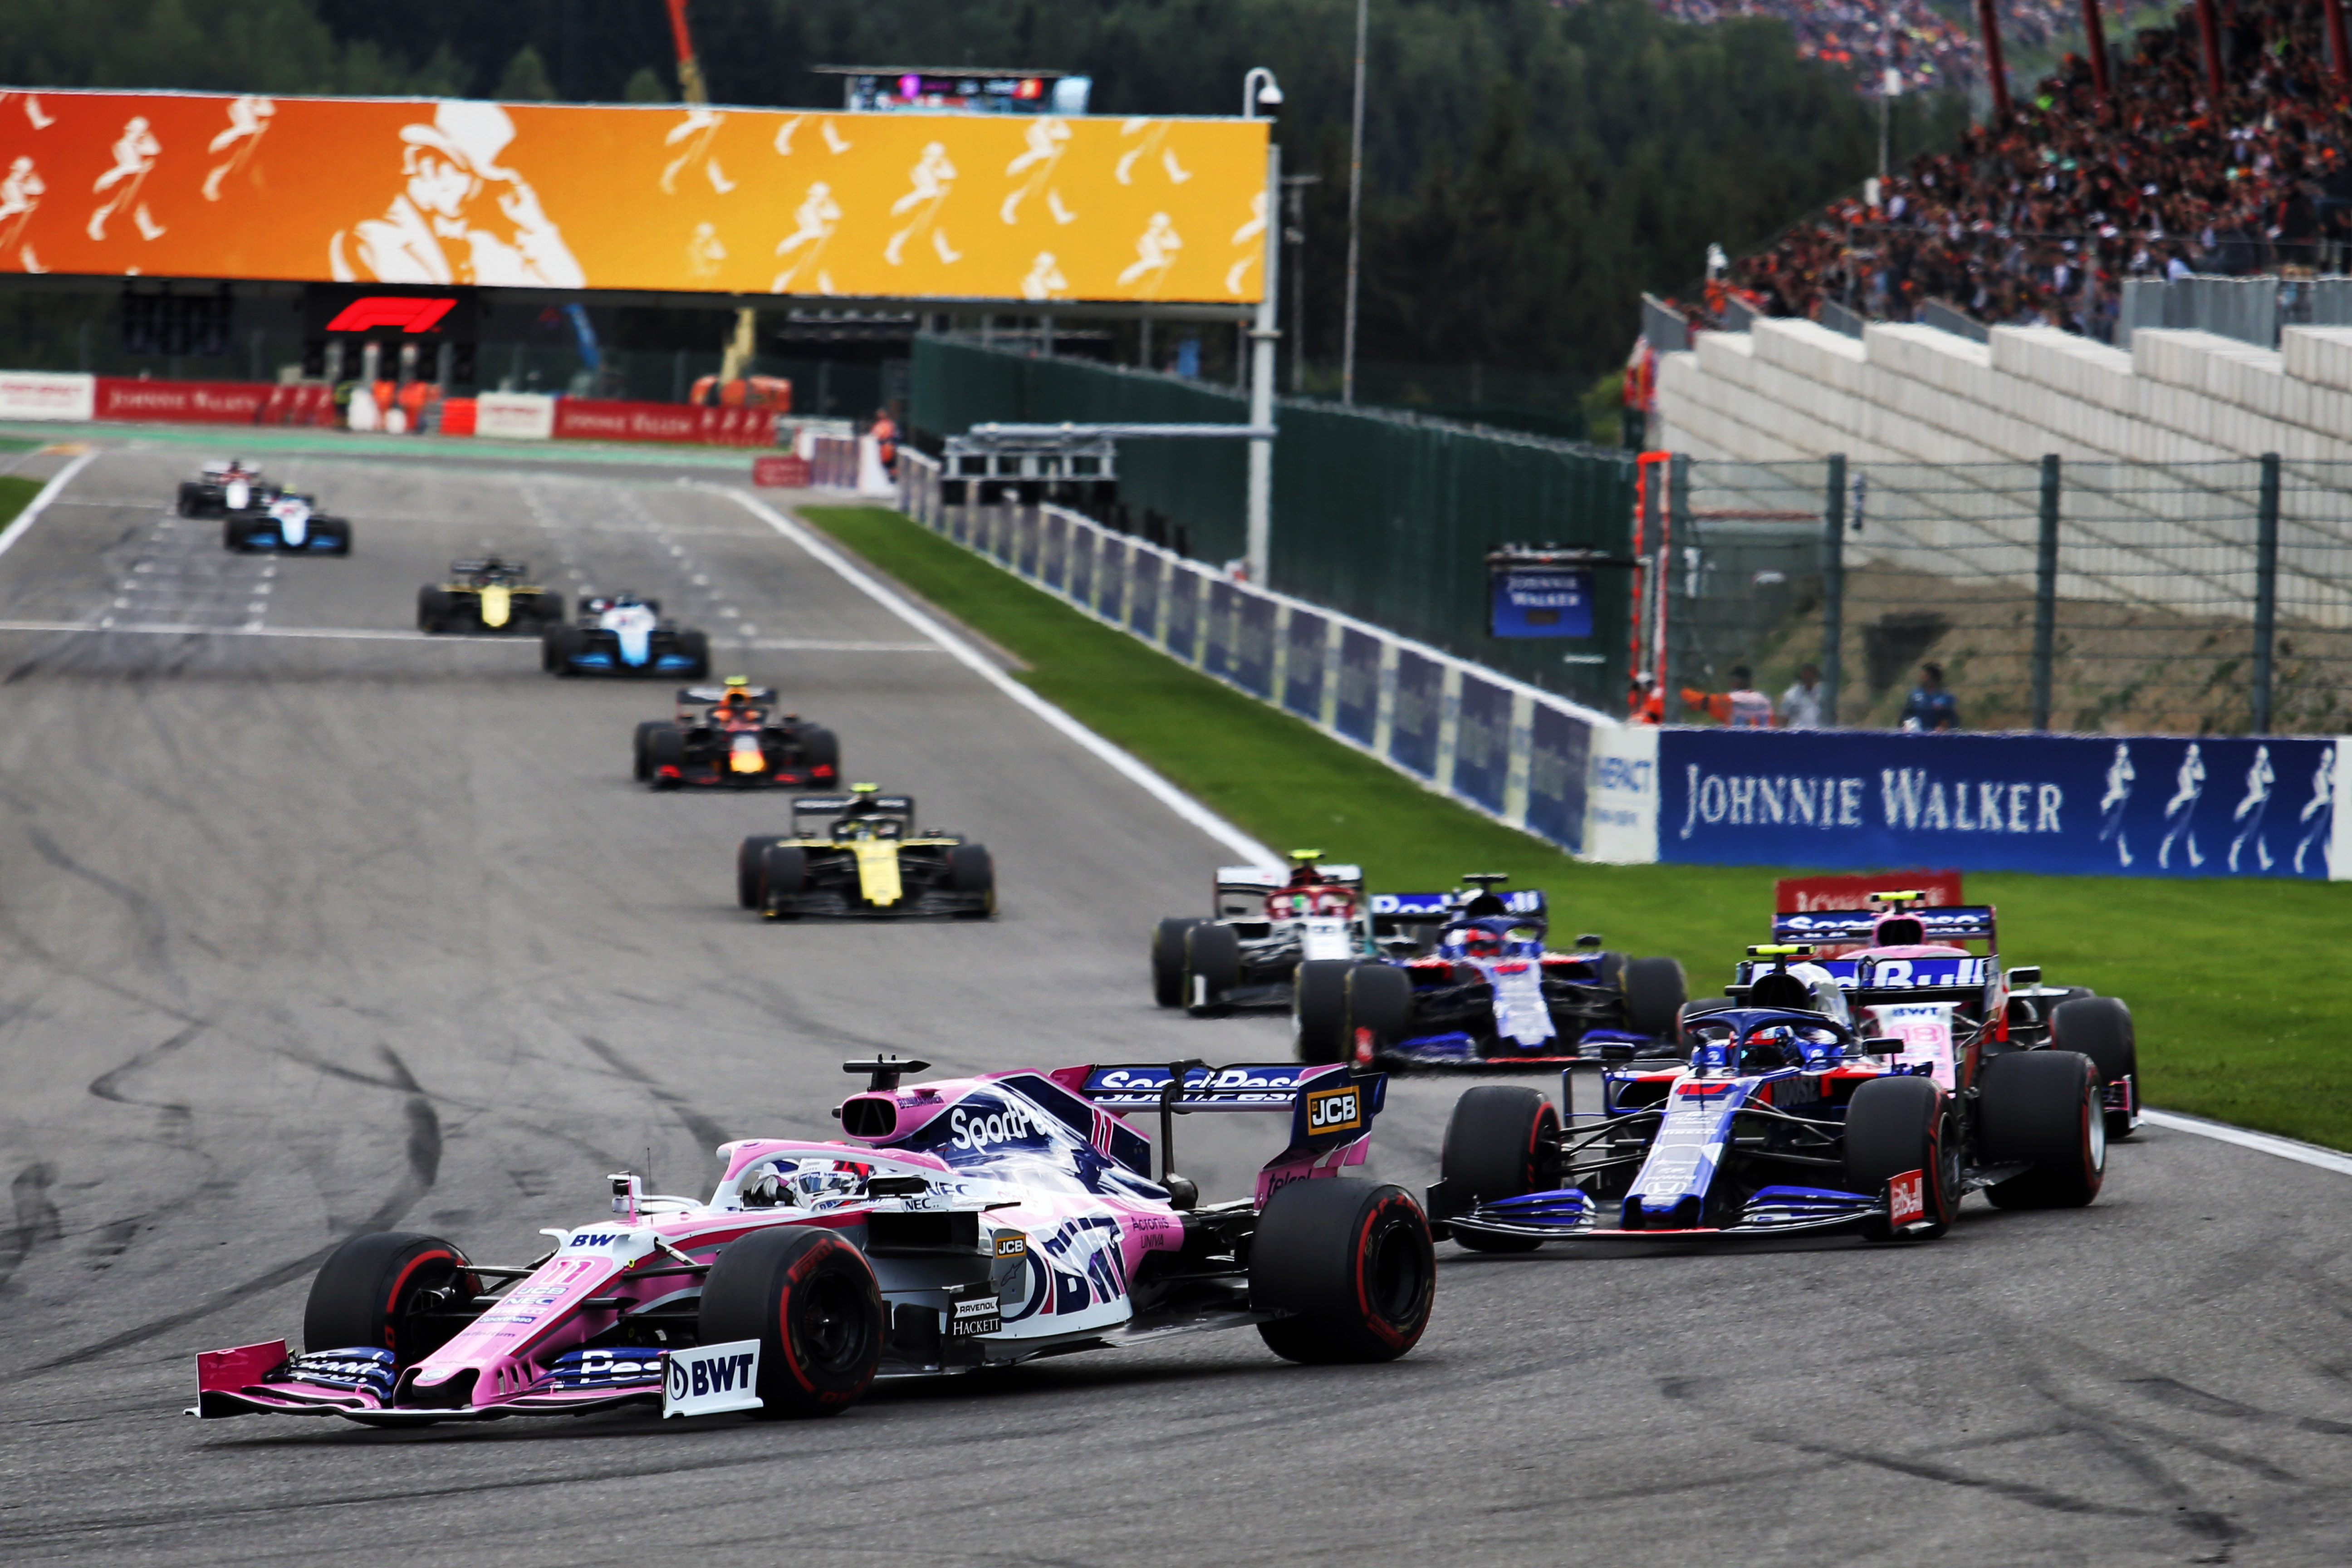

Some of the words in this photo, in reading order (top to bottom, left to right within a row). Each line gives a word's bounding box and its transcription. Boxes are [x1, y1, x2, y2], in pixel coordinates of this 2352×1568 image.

[1680, 763, 1865, 839] JOHNNIE
[1880, 767, 2063, 834] WALKER
[1312, 1095, 1356, 1126] JCB
[905, 1198, 931, 1210] NEC
[1131, 1216, 1169, 1231] Acronis
[998, 1240, 1024, 1254] JCB
[1141, 1234, 1164, 1249] UNIVA
[539, 1259, 595, 1285] 11
[960, 1302, 995, 1313] RAVENOL
[478, 1315, 534, 1323] SportPesa
[953, 1318, 1000, 1336] HACKETT
[691, 1353, 754, 1396] BWT
